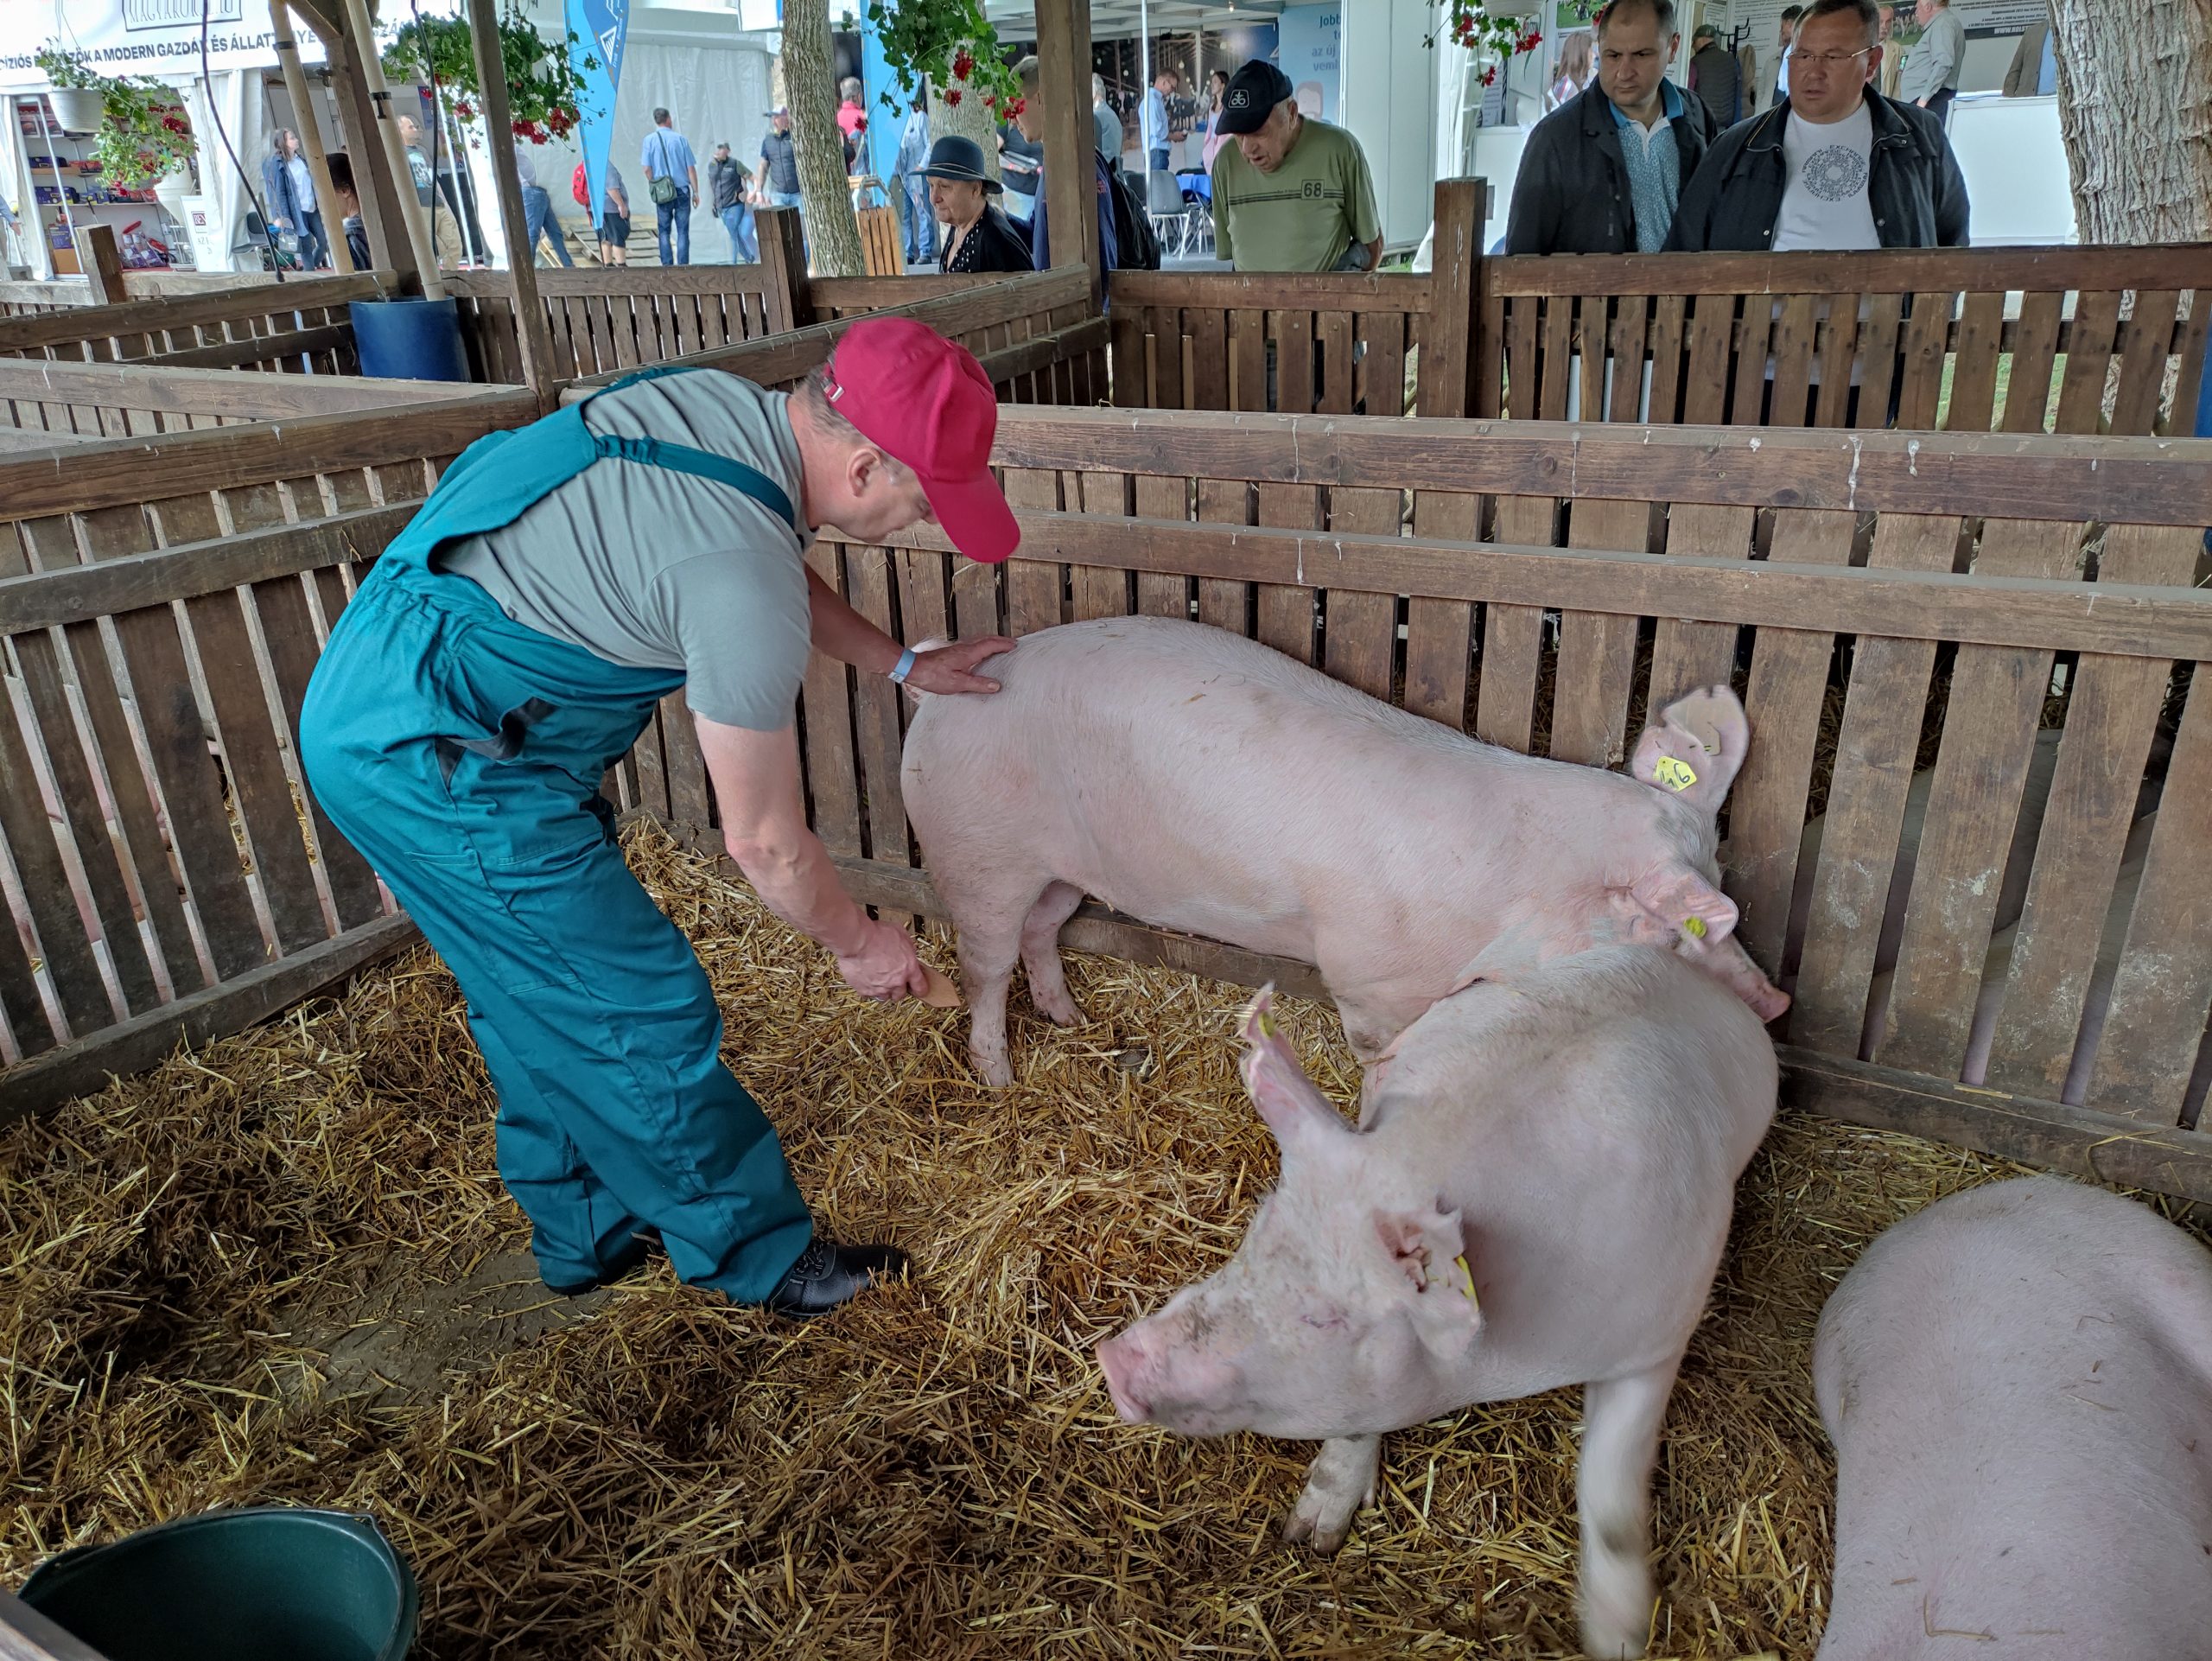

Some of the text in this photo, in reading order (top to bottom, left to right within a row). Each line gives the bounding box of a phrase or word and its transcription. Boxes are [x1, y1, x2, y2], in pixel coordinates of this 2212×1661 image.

[92, 49, 103, 62] A
[104, 43, 156, 62] MODERN
[212, 35, 227, 52] ÉS
[1312, 48, 1323, 57] az
[1303, 182, 1322, 198] 68
